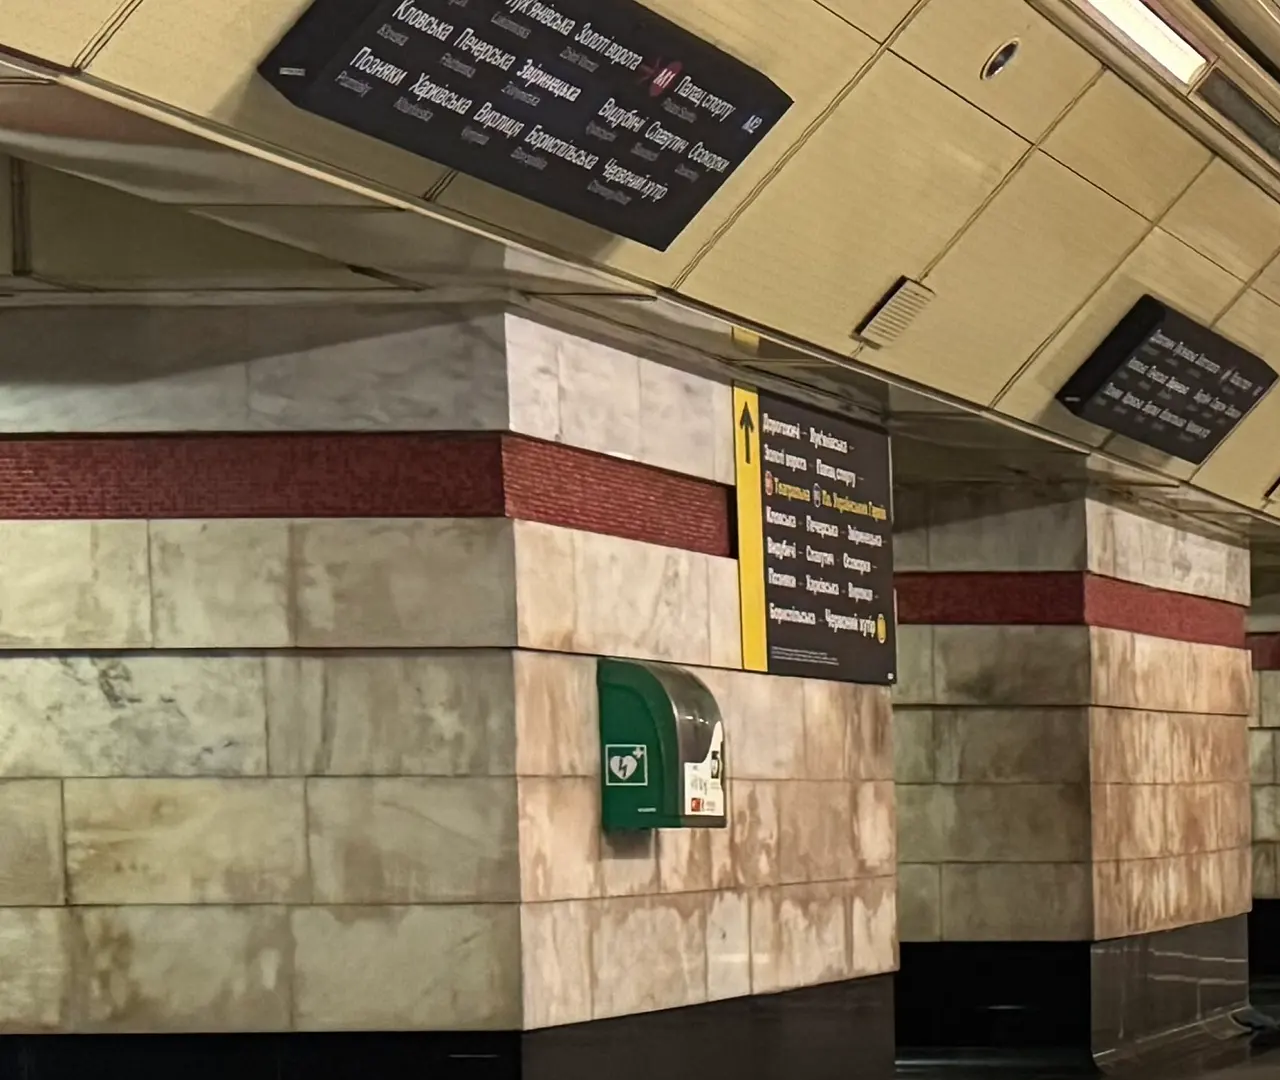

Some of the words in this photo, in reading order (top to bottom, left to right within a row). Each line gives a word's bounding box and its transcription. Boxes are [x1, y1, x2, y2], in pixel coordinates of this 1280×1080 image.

[392, 0, 454, 42] Кловська
[453, 28, 517, 71] Печерська
[516, 59, 582, 101] Звіринецька
[574, 22, 615, 58] Золоті
[604, 38, 643, 71] ворота
[349, 46, 409, 87] Позняки
[408, 72, 473, 115] Харківська
[472, 102, 525, 138] Вирлиця
[524, 124, 599, 170] Бориспільська
